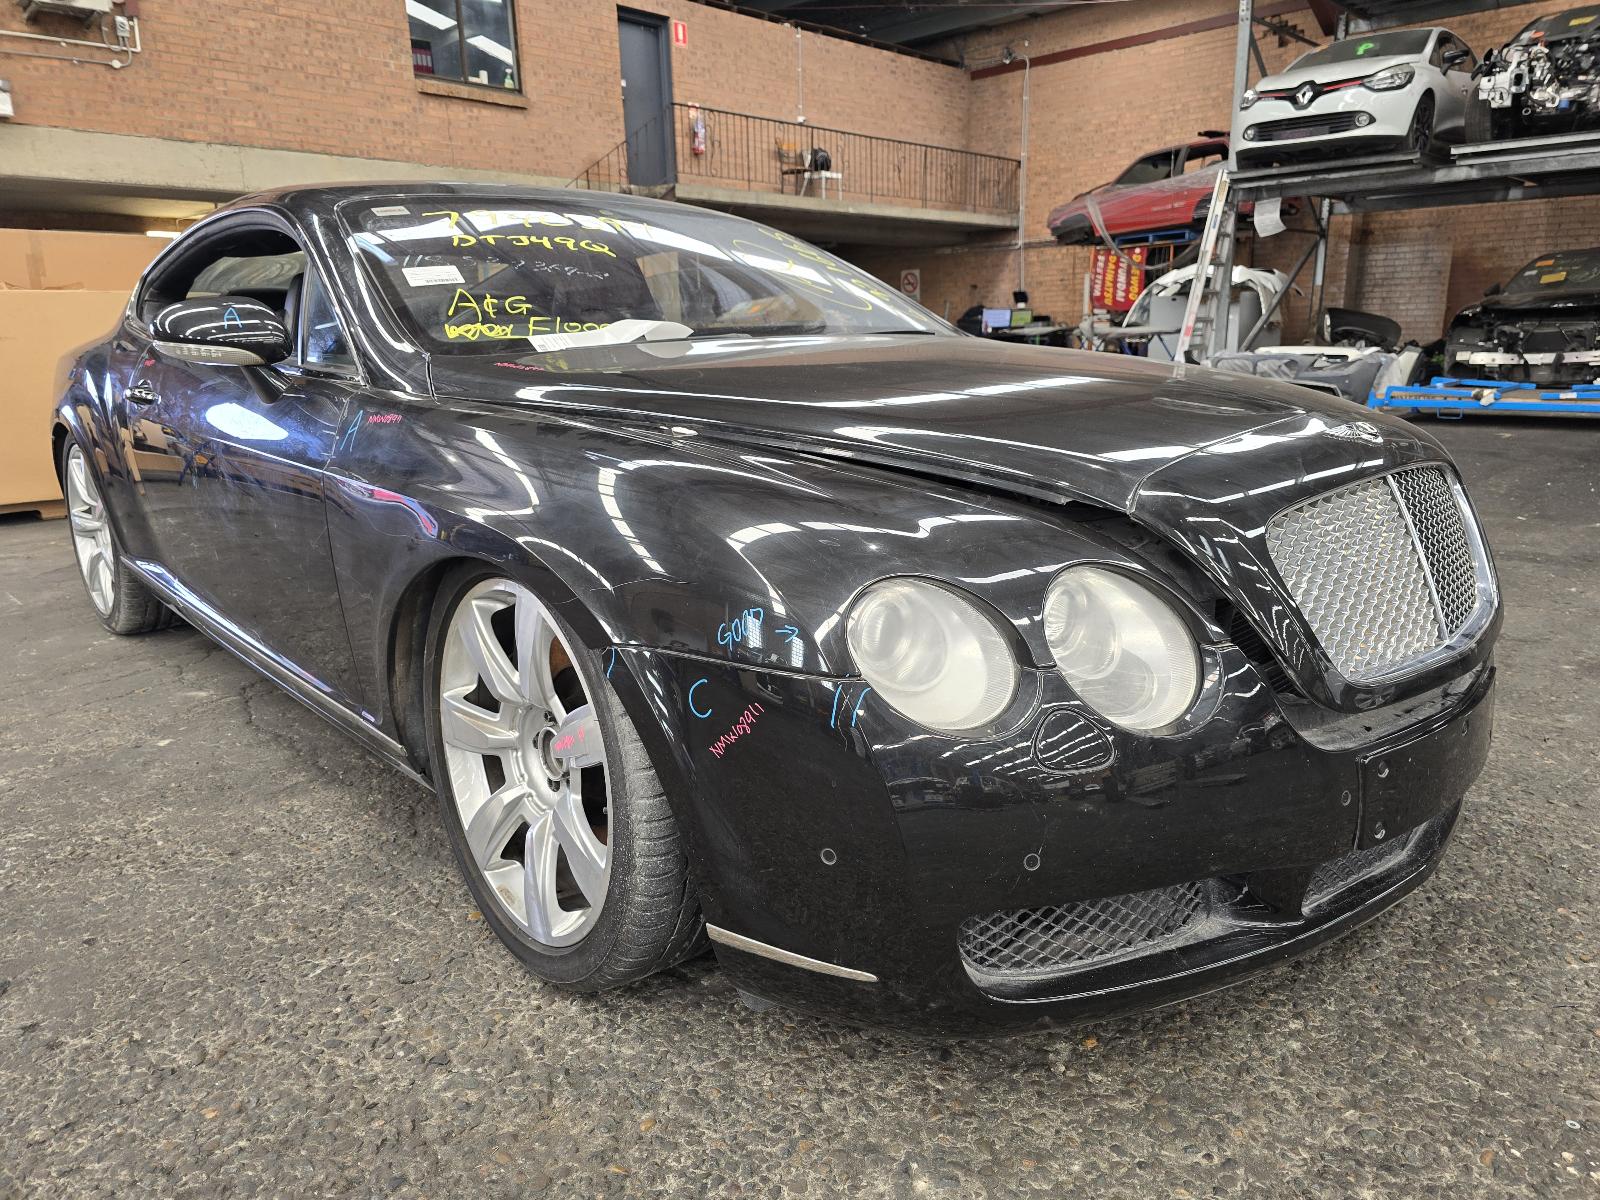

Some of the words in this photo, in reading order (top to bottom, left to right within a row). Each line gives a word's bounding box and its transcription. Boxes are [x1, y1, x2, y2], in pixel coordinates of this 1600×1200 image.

[1128, 253, 1142, 301] DEWOO
[223, 306, 243, 330] A
[717, 607, 764, 652] GOOD
[689, 678, 712, 719] C
